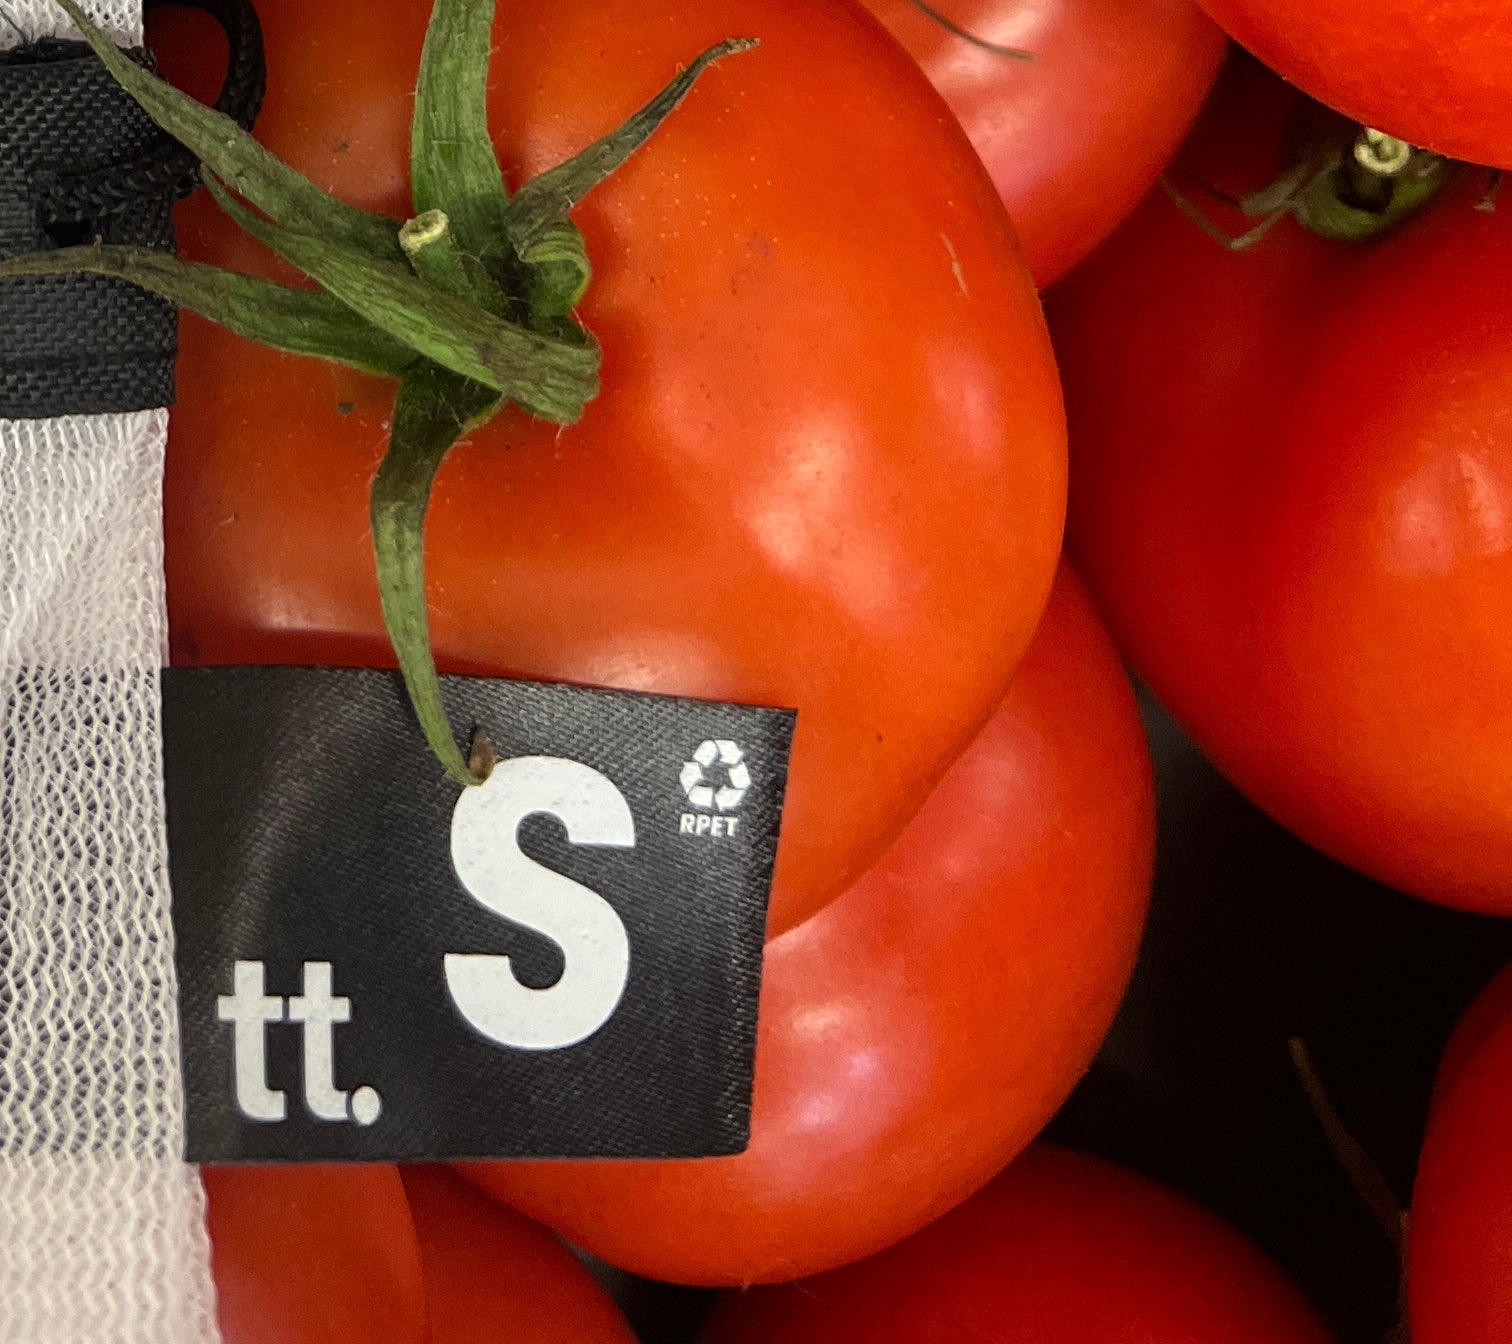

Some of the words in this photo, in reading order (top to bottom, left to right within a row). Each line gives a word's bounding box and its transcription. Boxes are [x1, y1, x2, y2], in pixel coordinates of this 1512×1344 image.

[443, 755, 637, 1051] S
[679, 813, 740, 838] RPET
[218, 961, 383, 1127] tt.
